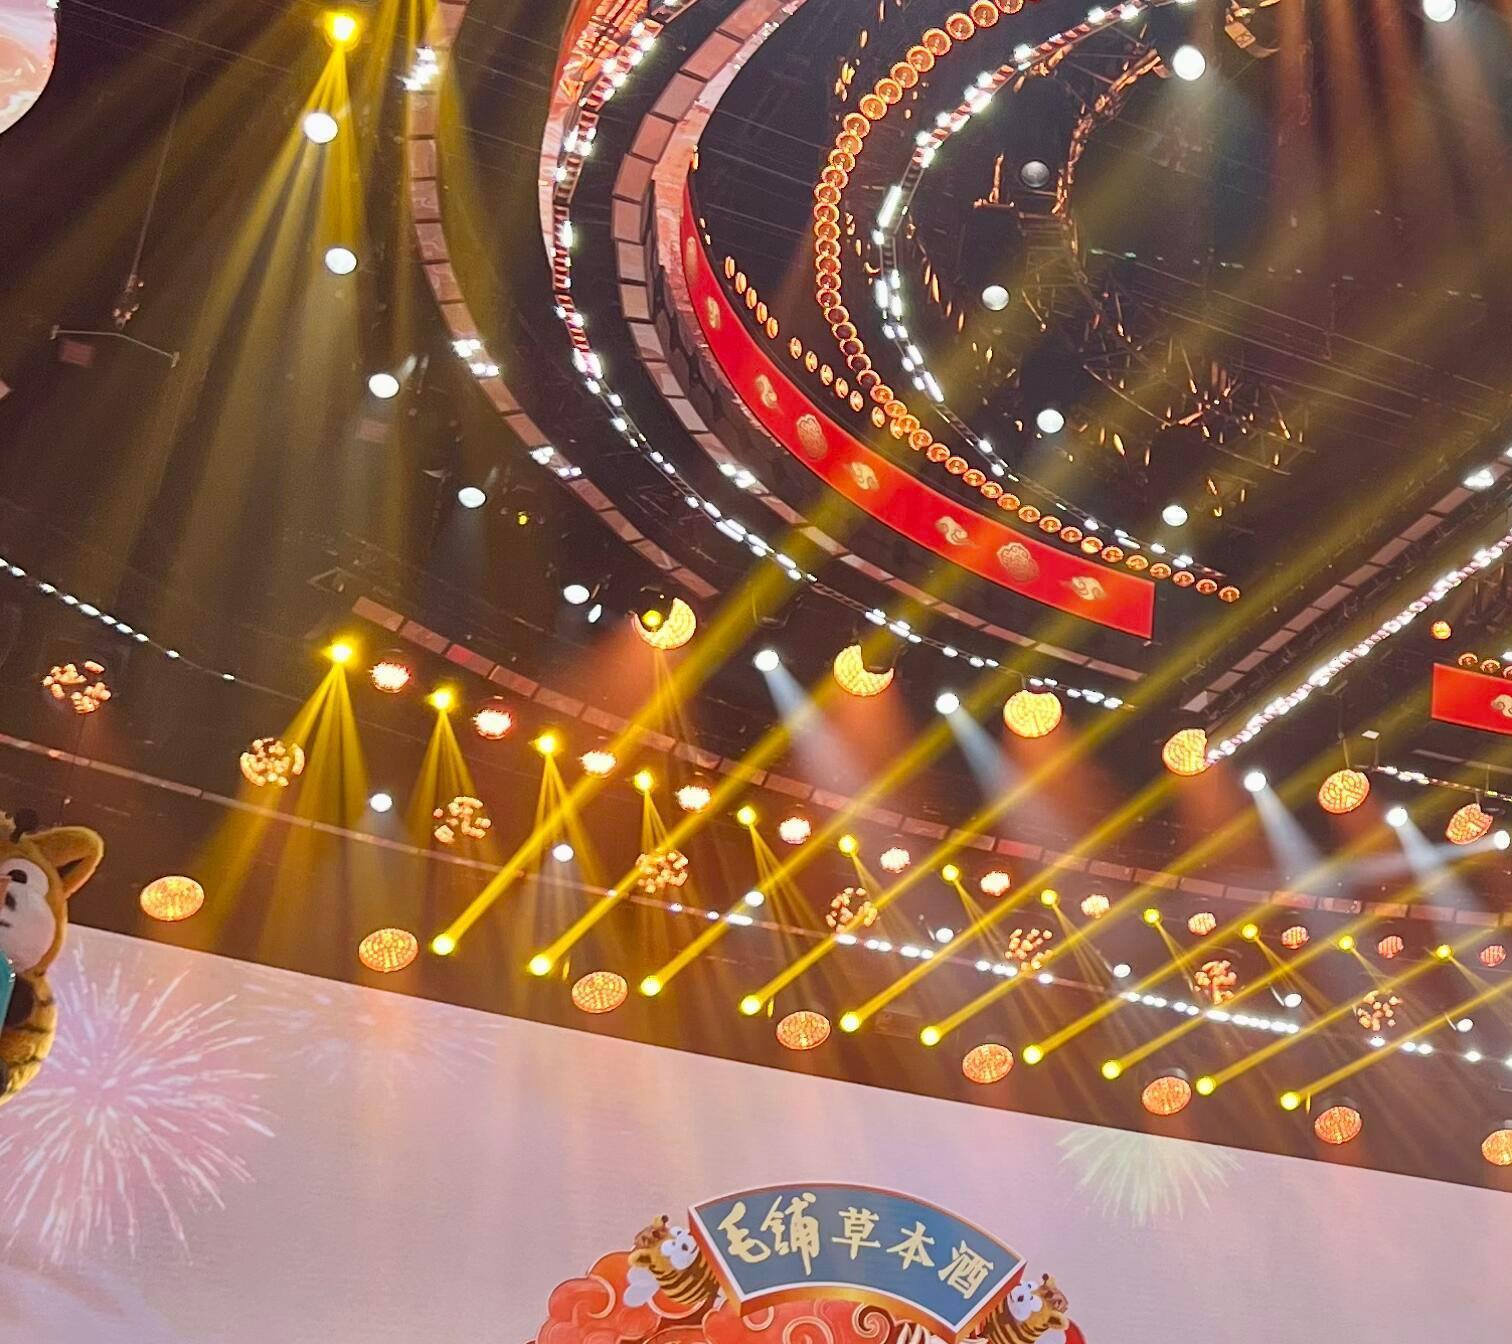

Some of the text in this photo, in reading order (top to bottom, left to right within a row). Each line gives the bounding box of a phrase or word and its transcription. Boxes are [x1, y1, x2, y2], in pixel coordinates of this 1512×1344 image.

[717, 1191, 995, 1300] 毛铺草本酒
